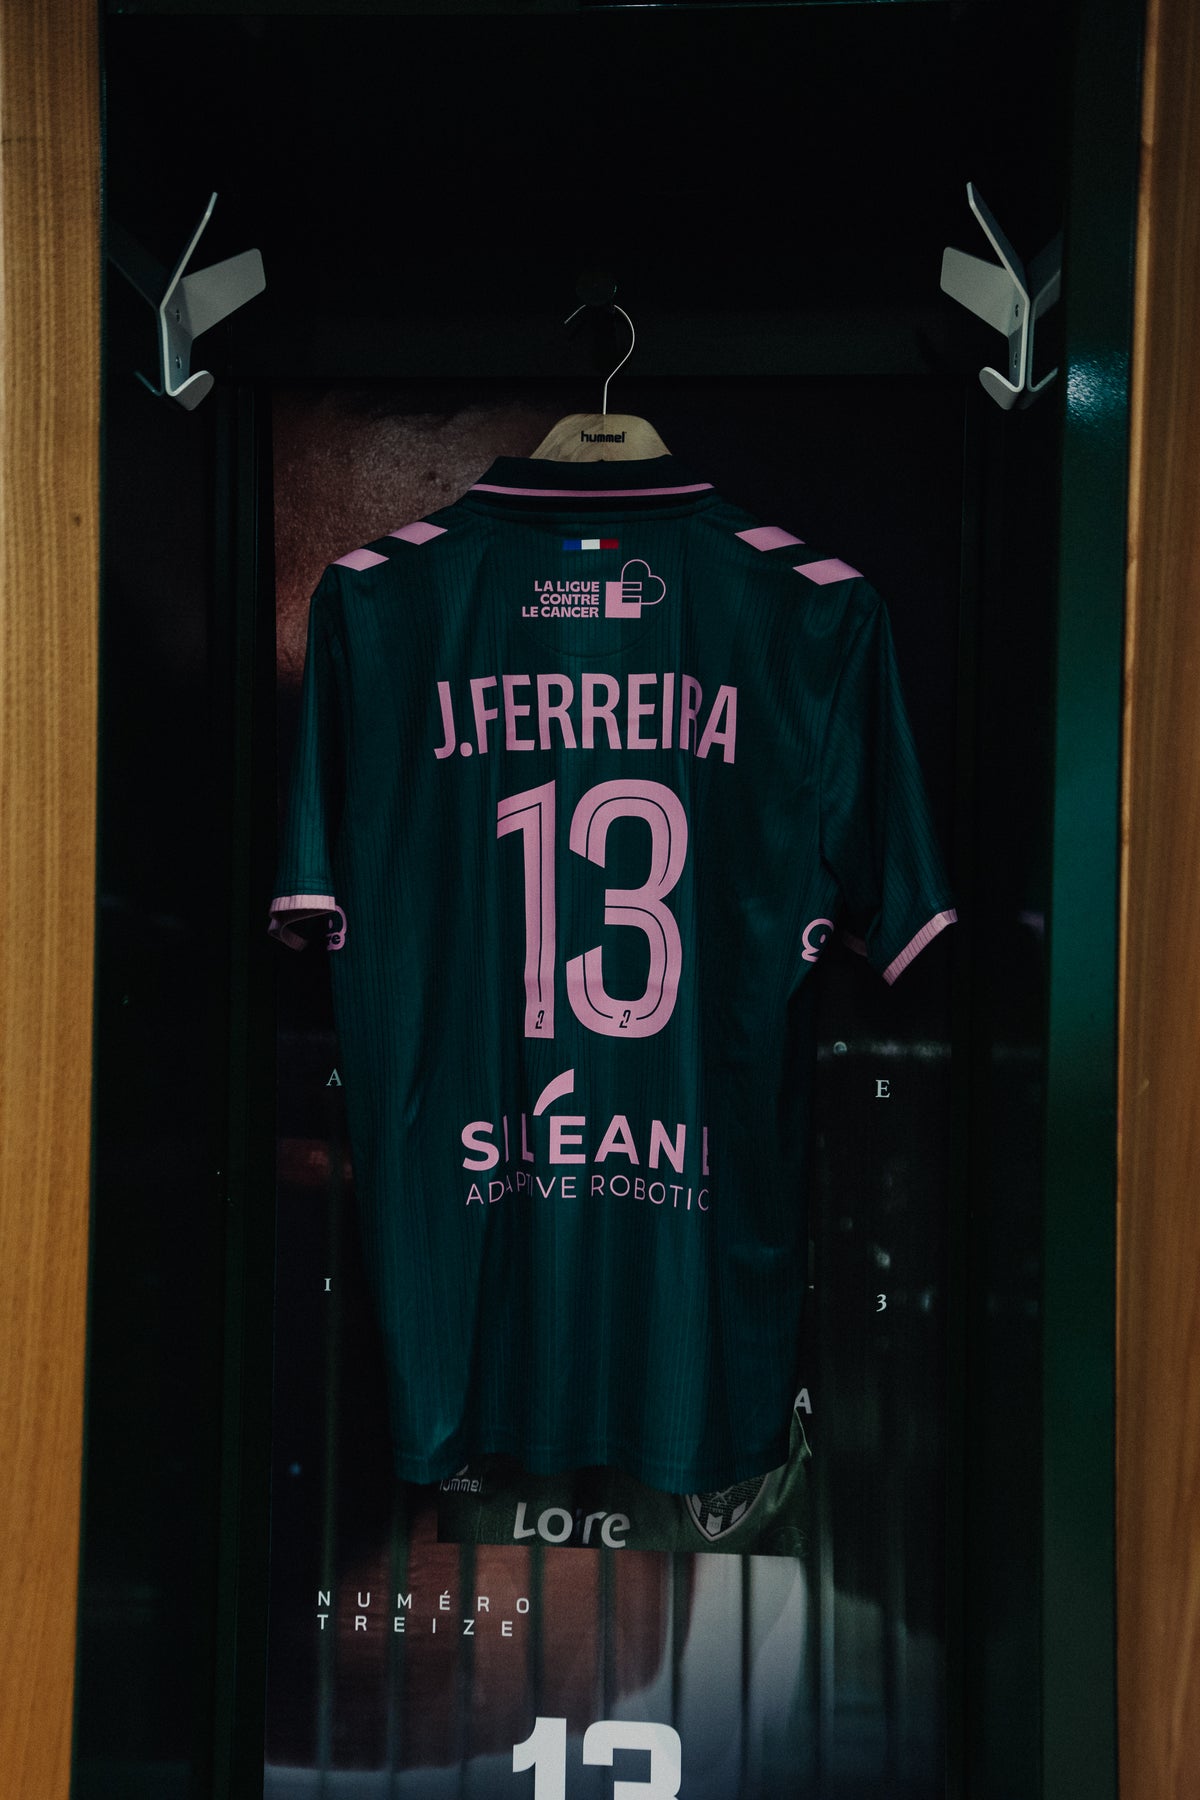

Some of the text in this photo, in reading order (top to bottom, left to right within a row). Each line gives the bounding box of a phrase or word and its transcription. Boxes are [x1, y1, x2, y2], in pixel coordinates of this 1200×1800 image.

[581, 430, 626, 442] hummel
[534, 580, 599, 592] LA LIGUE
[540, 593, 599, 605] CONTRE
[521, 606, 599, 618] LE CANCER
[433, 672, 738, 764] J.FERREIRA
[496, 779, 688, 1039] 13
[326, 1068, 342, 1087] A
[875, 1080, 890, 1098] E
[876, 1294, 887, 1312] 3
[440, 1476, 482, 1493] ummel
[318, 1590, 530, 1614] NUMÉRO
[317, 1614, 513, 1637] TREIZE
